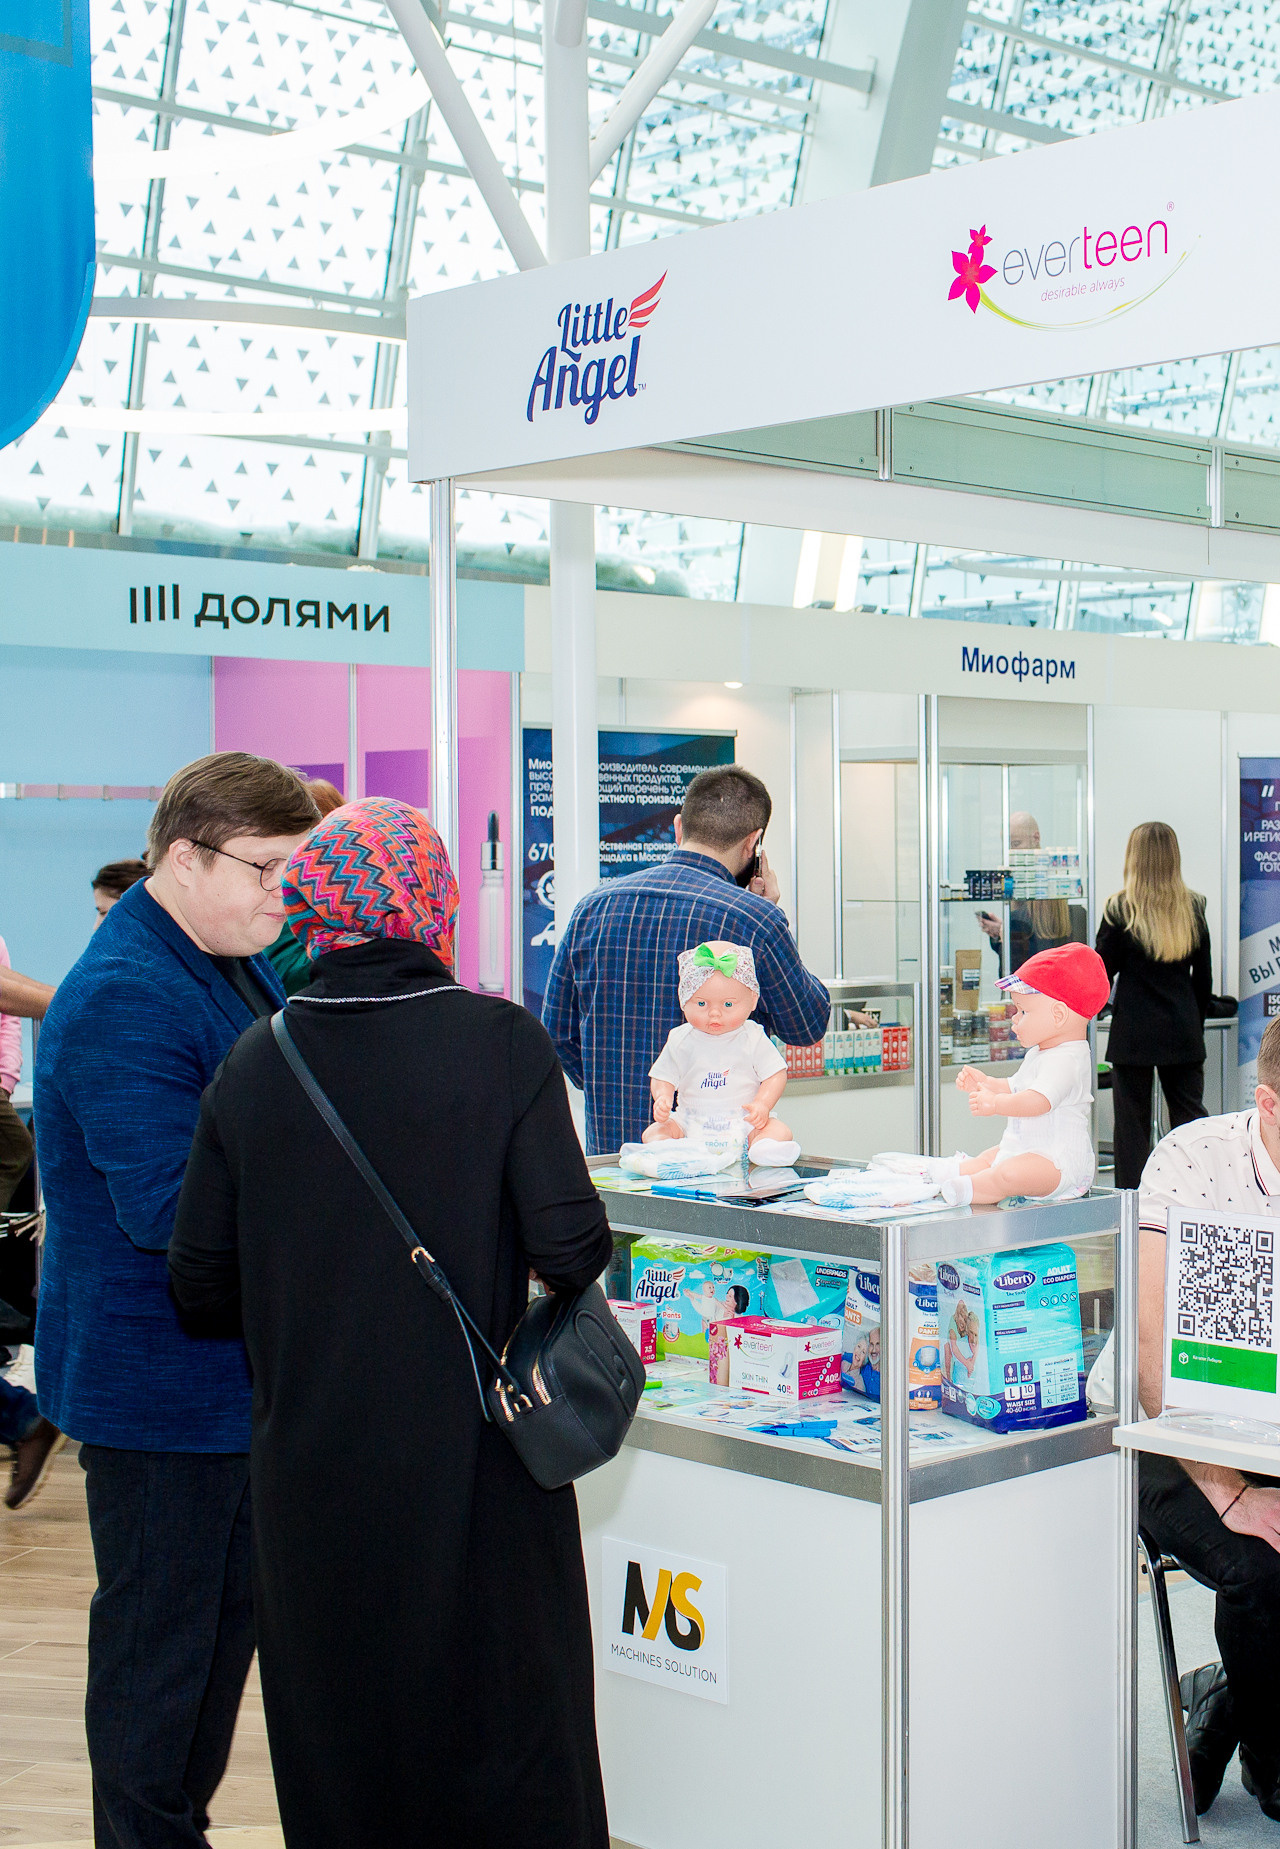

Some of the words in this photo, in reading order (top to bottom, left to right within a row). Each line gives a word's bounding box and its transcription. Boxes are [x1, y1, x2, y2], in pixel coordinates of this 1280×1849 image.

[1003, 219, 1168, 286] everteen
[1041, 284, 1087, 302] desirable
[1089, 276, 1125, 295] always
[556, 297, 629, 363] Little
[526, 334, 642, 425] Angel
[194, 592, 390, 633] долями
[962, 646, 1076, 684] Миофарм
[599, 763, 658, 774] оизводитель
[632, 774, 684, 785] продуктов,
[623, 784, 670, 795] перечень
[599, 795, 635, 804] актного
[1244, 832, 1253, 842] И
[599, 842, 642, 852] бственная
[1249, 961, 1276, 984] ВЫ
[707, 1071, 723, 1080] Little
[700, 1077, 727, 1090] Angel
[816, 1266, 848, 1279] UNDERPADS
[1046, 1264, 1071, 1275] ADULT
[645, 1269, 673, 1285] Little
[939, 1265, 960, 1289] Liberty
[996, 1272, 1034, 1287] Liberty
[1044, 1276, 1055, 1285] ECO
[1055, 1272, 1076, 1282] DIAPERS
[636, 1279, 677, 1303] Angel
[858, 1274, 880, 1296] Liber
[917, 1299, 938, 1309] Liber
[662, 1310, 682, 1320] Pants
[845, 1308, 861, 1323] ANTS
[743, 1340, 774, 1352] everteen
[811, 1339, 835, 1351] everteen
[741, 1373, 754, 1383] SKIN
[754, 1374, 769, 1384] THIN
[777, 1383, 787, 1393] 40
[1008, 1388, 1015, 1399] L
[1023, 1385, 1033, 1393] 10
[1005, 1406, 1023, 1414] 40-60
[1006, 1400, 1024, 1408] WAIST
[611, 1643, 662, 1668] MACHINES
[664, 1658, 717, 1684] SOLUTION
